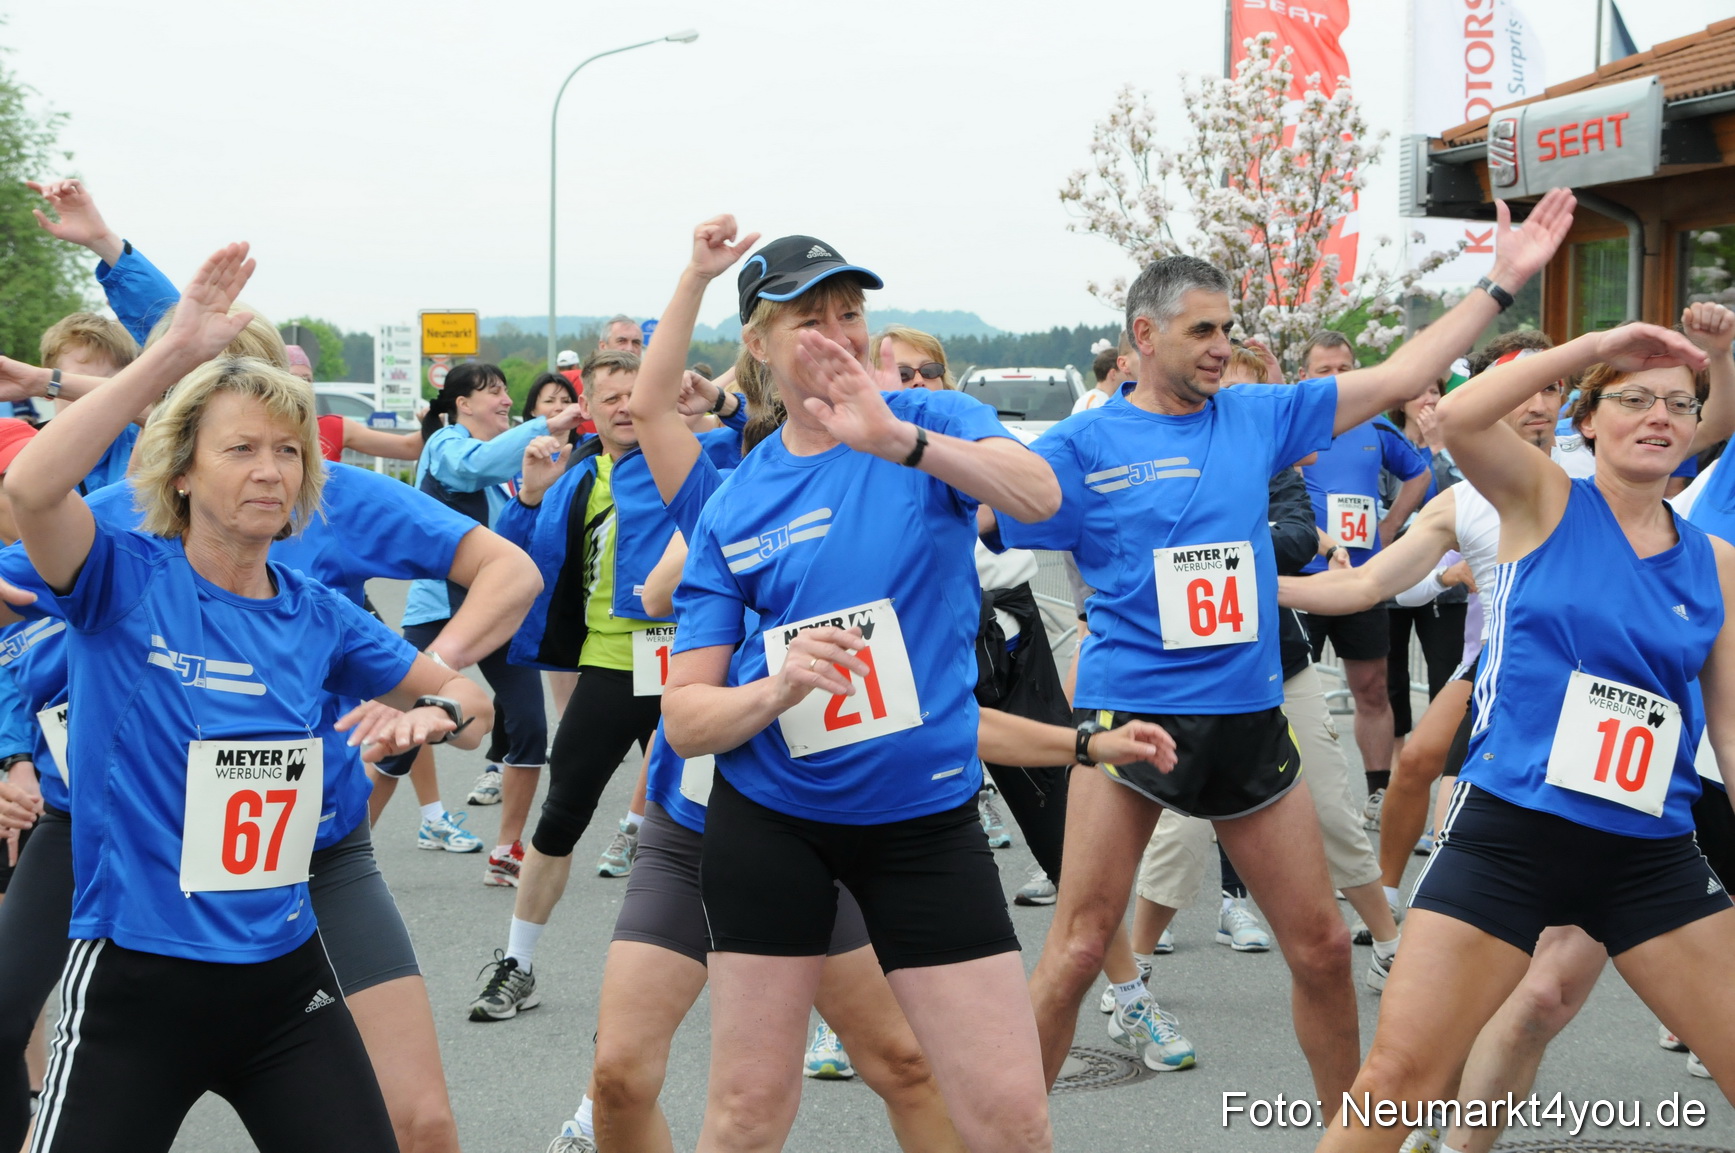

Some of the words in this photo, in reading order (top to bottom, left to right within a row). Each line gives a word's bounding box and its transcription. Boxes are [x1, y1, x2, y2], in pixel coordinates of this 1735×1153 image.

[1537, 112, 1630, 162] SEAT
[806, 251, 832, 259] adidas
[426, 328, 472, 339] Neumarkt
[1341, 511, 1368, 542] 54
[1173, 548, 1221, 564] MEYER
[1173, 560, 1223, 573] WERBUNG
[1186, 575, 1244, 637] 64
[645, 635, 676, 643] WERBUN
[1590, 682, 1648, 710] MEYER
[1588, 695, 1645, 720] WERBUNG
[215, 749, 283, 766] MEYER
[1593, 717, 1654, 792] 10
[215, 767, 283, 780] WERBUNG
[221, 789, 298, 875] 67
[304, 996, 336, 1013] adidas
